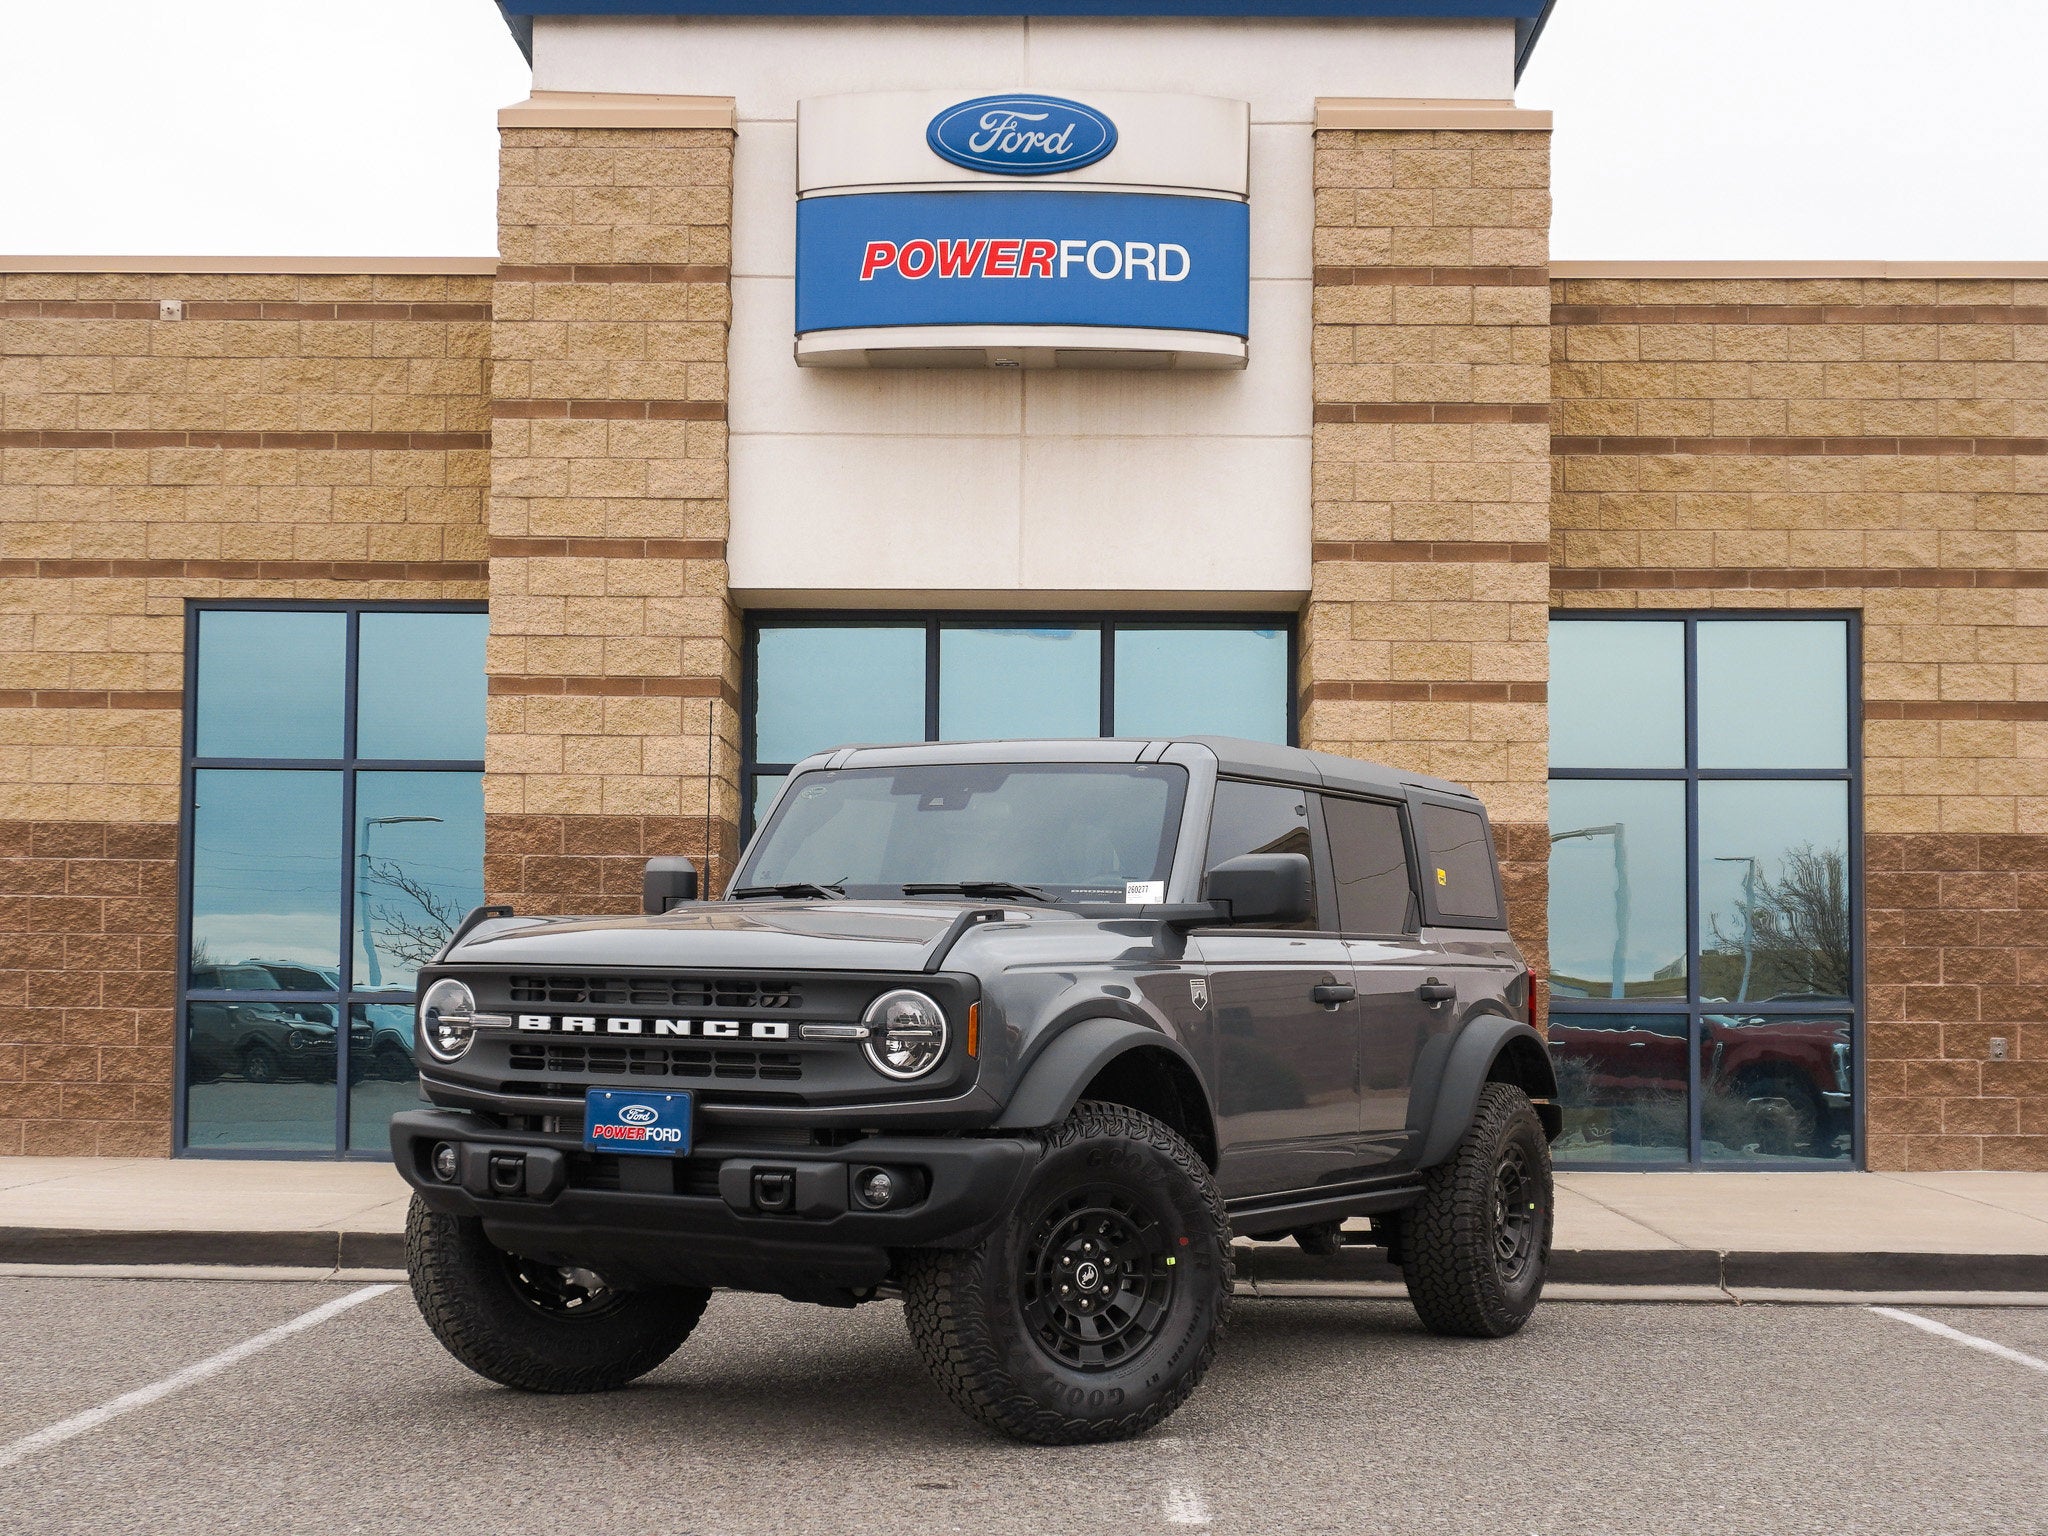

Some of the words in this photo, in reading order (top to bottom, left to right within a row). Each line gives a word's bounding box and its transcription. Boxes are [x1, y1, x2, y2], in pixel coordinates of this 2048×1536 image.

[968, 110, 1075, 155] Ford
[1127, 885, 1148, 894] 260277
[518, 1014, 790, 1039] BRONCO
[626, 1108, 651, 1121] Ford
